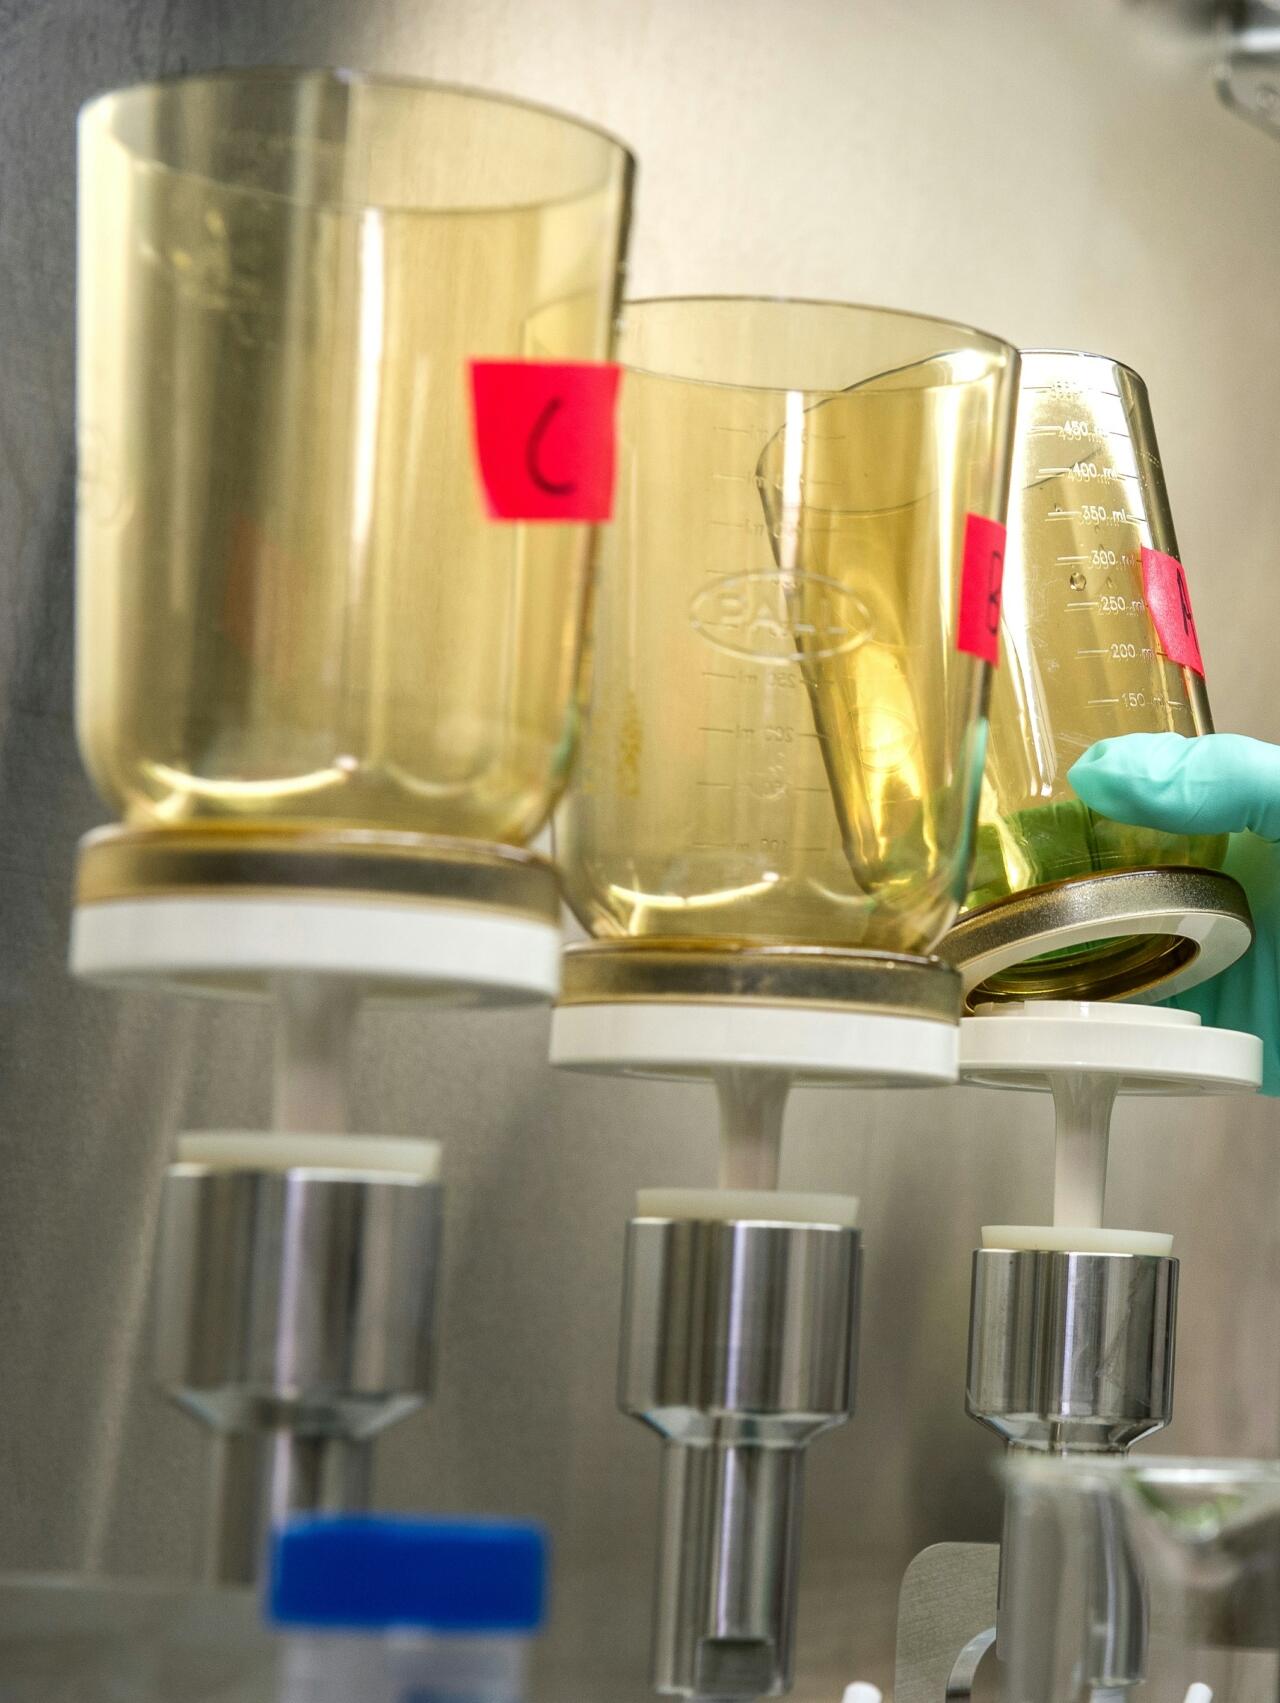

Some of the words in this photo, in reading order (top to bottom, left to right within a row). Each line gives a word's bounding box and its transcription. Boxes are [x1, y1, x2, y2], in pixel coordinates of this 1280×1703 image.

[1062, 420, 1089, 437] 450
[525, 398, 577, 497] C
[1072, 462, 1098, 479] 400
[1081, 505, 1107, 521] 350
[1112, 509, 1127, 522] ml
[1091, 550, 1117, 566] 300
[1100, 597, 1126, 612] 250
[1110, 644, 1136, 659] 200
[1121, 693, 1145, 707] 150
